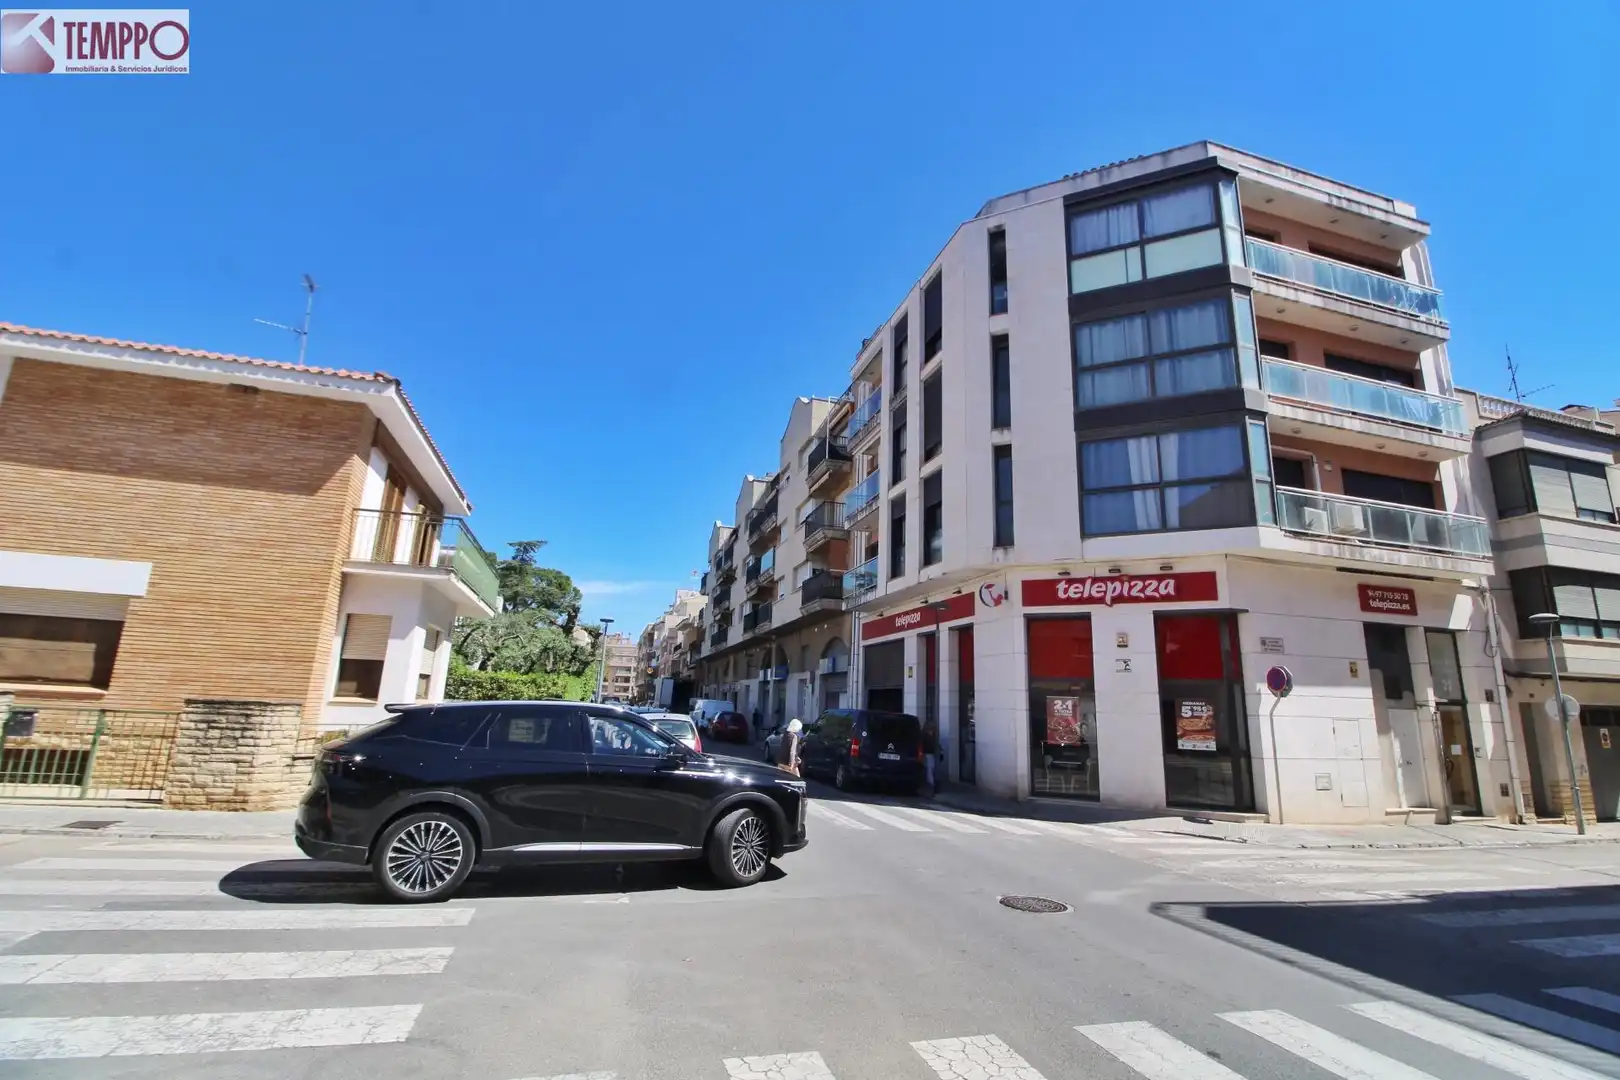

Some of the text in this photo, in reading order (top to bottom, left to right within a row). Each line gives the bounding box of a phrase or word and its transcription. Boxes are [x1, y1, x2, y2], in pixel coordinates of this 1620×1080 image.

[1056, 578, 1175, 605] telepizza
[1370, 599, 1410, 611] telepizza.es
[895, 611, 921, 629] telepizza
